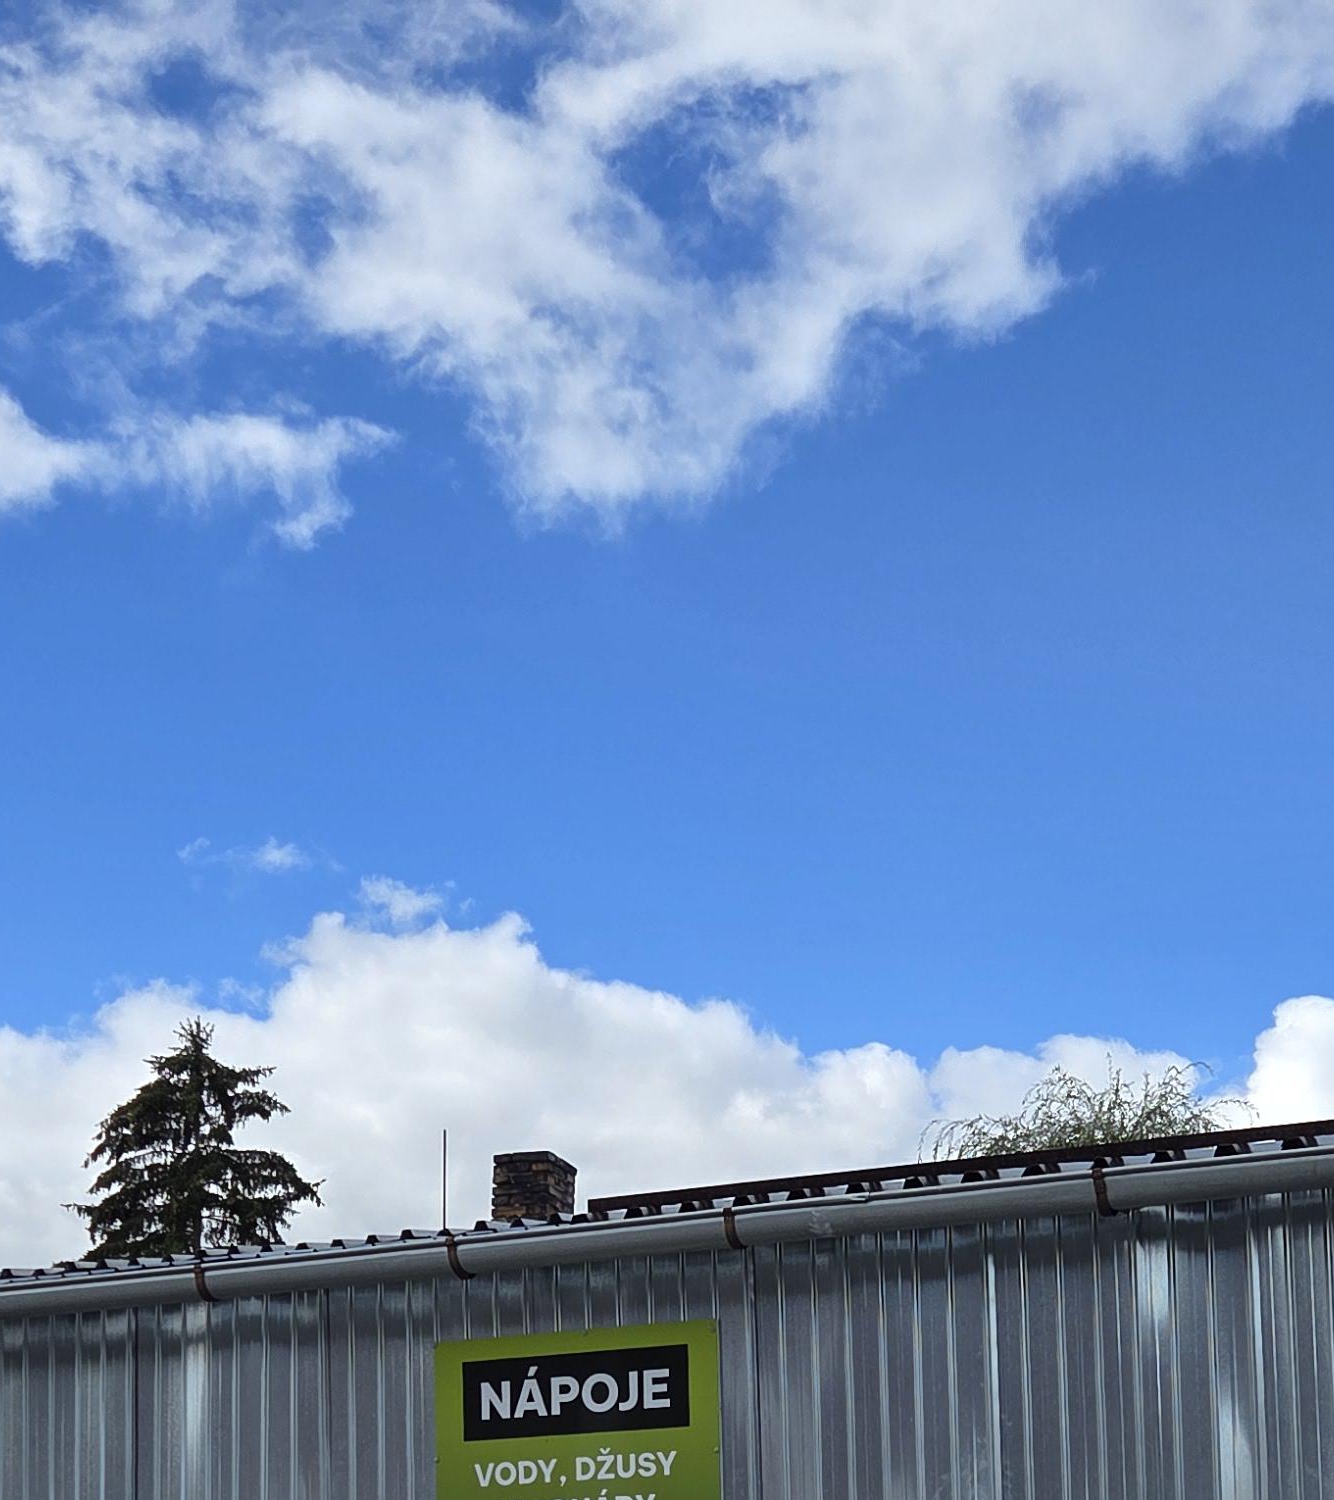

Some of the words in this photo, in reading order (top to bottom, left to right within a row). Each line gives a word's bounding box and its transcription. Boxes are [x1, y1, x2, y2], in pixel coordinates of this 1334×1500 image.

[480, 1366, 671, 1421] NÁPOJE
[474, 1458, 568, 1488] VODY,
[575, 1447, 677, 1482] DŽUSY
